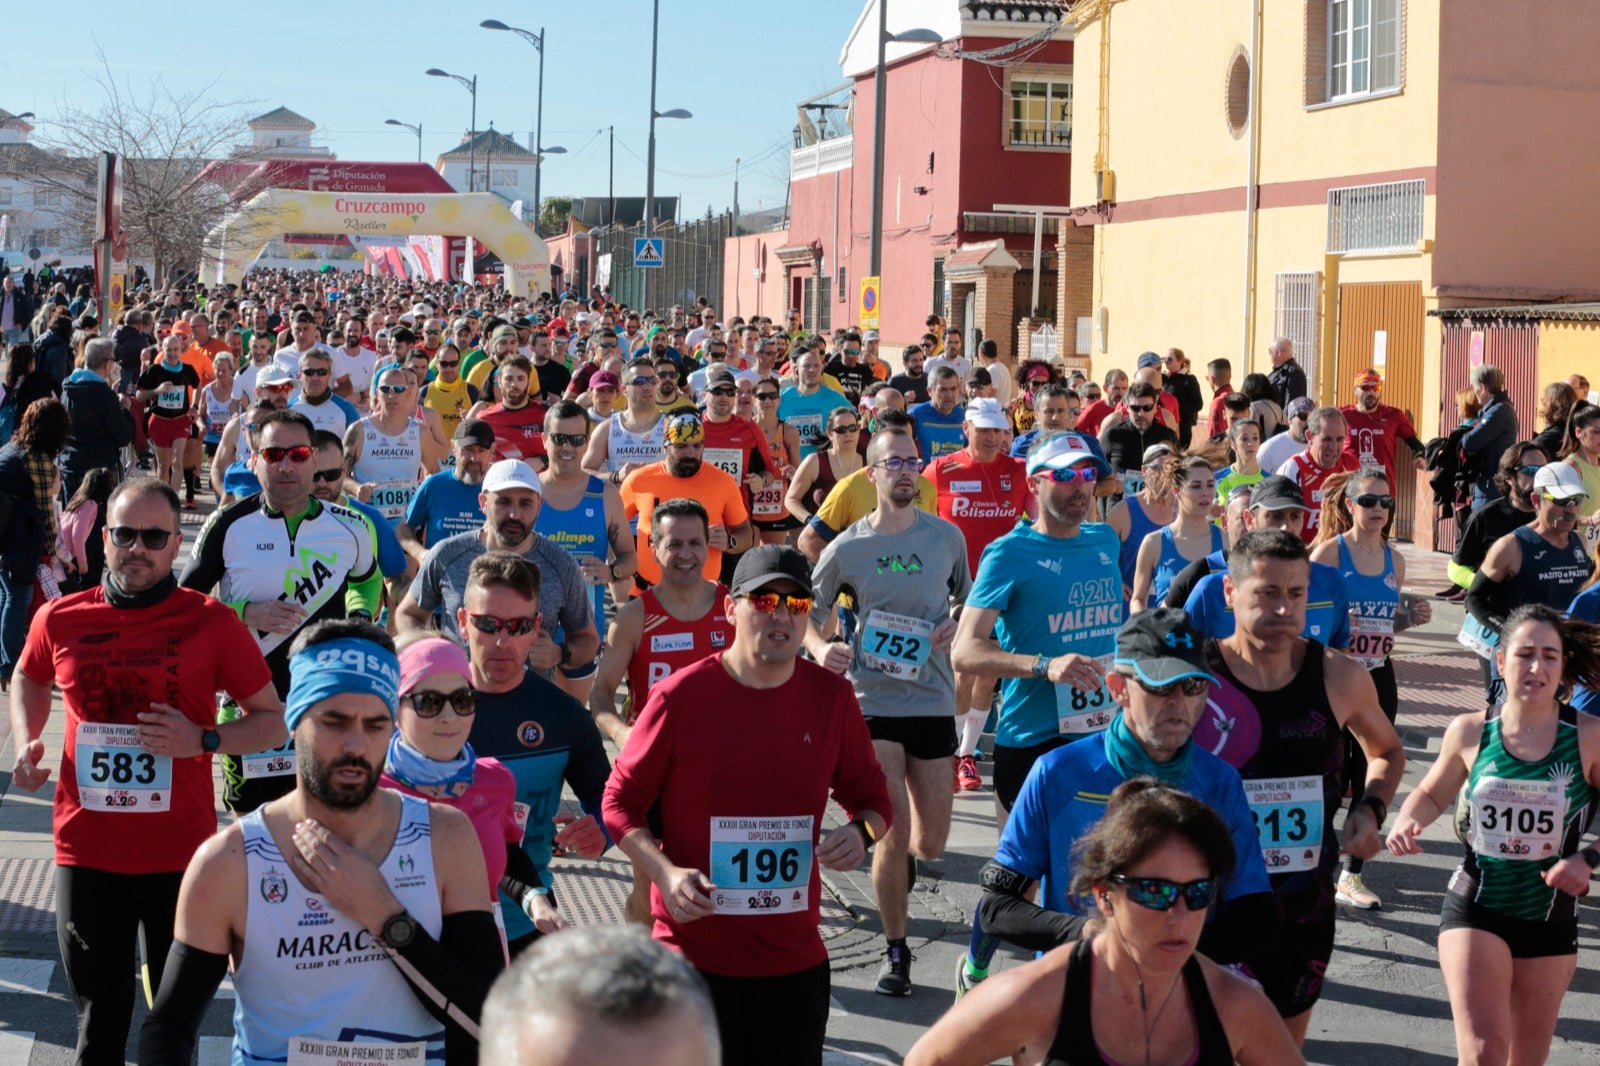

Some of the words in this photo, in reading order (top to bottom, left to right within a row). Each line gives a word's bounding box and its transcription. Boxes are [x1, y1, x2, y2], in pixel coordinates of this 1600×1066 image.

[332, 169, 386, 180] Diputación
[332, 181, 344, 191] de
[345, 181, 386, 192] Granada
[335, 198, 426, 215] Cruzcampo
[344, 217, 387, 231] Radler
[163, 392, 180, 401] 964
[371, 448, 414, 456] MARACENA
[616, 446, 661, 455] MARACENA
[376, 490, 410, 505] 1081
[952, 497, 1016, 517] Polisalud
[548, 531, 595, 545] olimpo
[1538, 571, 1562, 580] PAZITO
[1068, 577, 1117, 608] 42K
[1062, 634, 1072, 643] WE
[1074, 631, 1088, 640] ARE
[874, 630, 920, 661] 752
[124, 659, 162, 667] FONDO
[100, 726, 114, 735] GRAN
[90, 751, 156, 784] 583
[1264, 782, 1287, 790] PREMIO
[1298, 780, 1317, 789] FONDO
[719, 820, 737, 829] XXXIII
[740, 820, 757, 829] GRAN
[759, 820, 781, 829] PREMIO
[783, 820, 791, 829] DE
[792, 819, 810, 829] FONDO
[1481, 804, 1554, 834] 3105
[748, 831, 786, 841] DIPUTACIÓN
[731, 848, 799, 883] 196
[298, 918, 335, 926] GARRIDO
[277, 929, 376, 958] MARAC
[295, 960, 324, 970] CLUB
[327, 959, 340, 967] DE
[299, 1041, 324, 1056] XXXIII
[325, 1045, 350, 1058] GRAN
[352, 1047, 383, 1060] PREMIO
[385, 1048, 394, 1060] DE
[397, 1047, 420, 1059] FONDO
